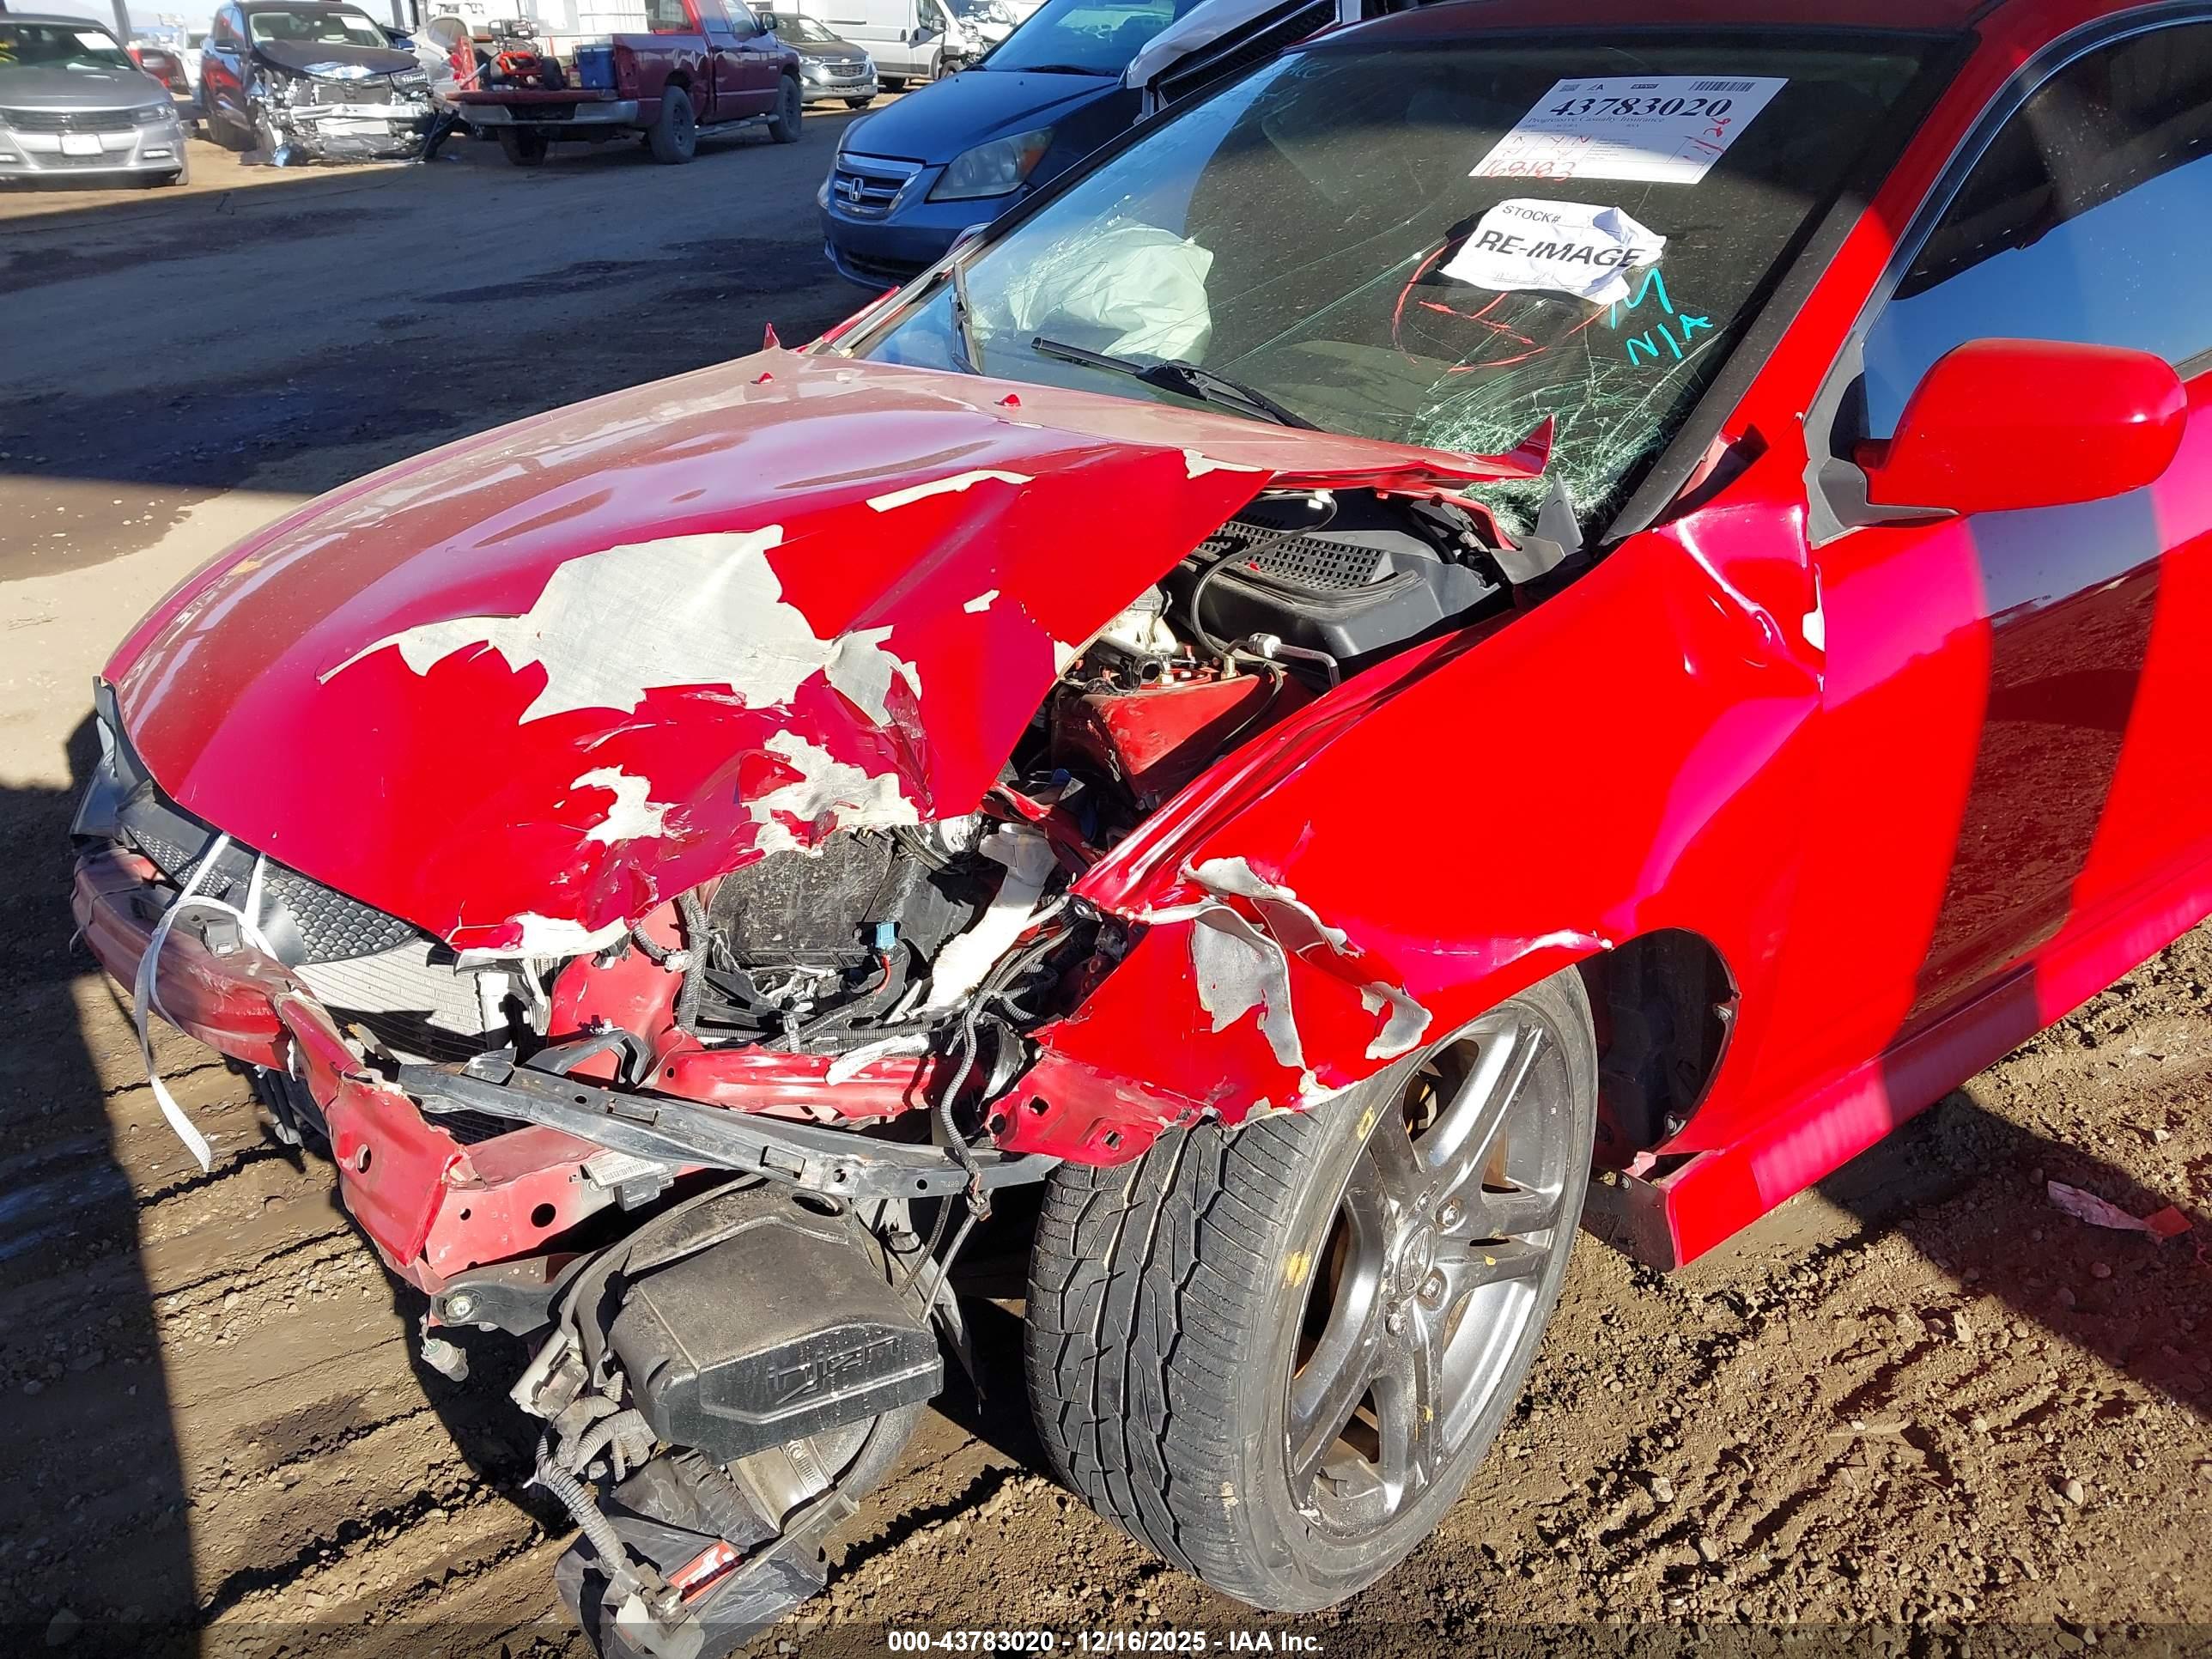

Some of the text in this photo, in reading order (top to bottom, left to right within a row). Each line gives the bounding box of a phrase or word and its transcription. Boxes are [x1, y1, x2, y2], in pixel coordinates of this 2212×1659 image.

[1550, 98, 1733, 117] 43783020
[1502, 205, 1562, 225] STOCK#
[1474, 229, 1646, 268] RE-IMAGE
[1626, 314, 1714, 366] N/A
